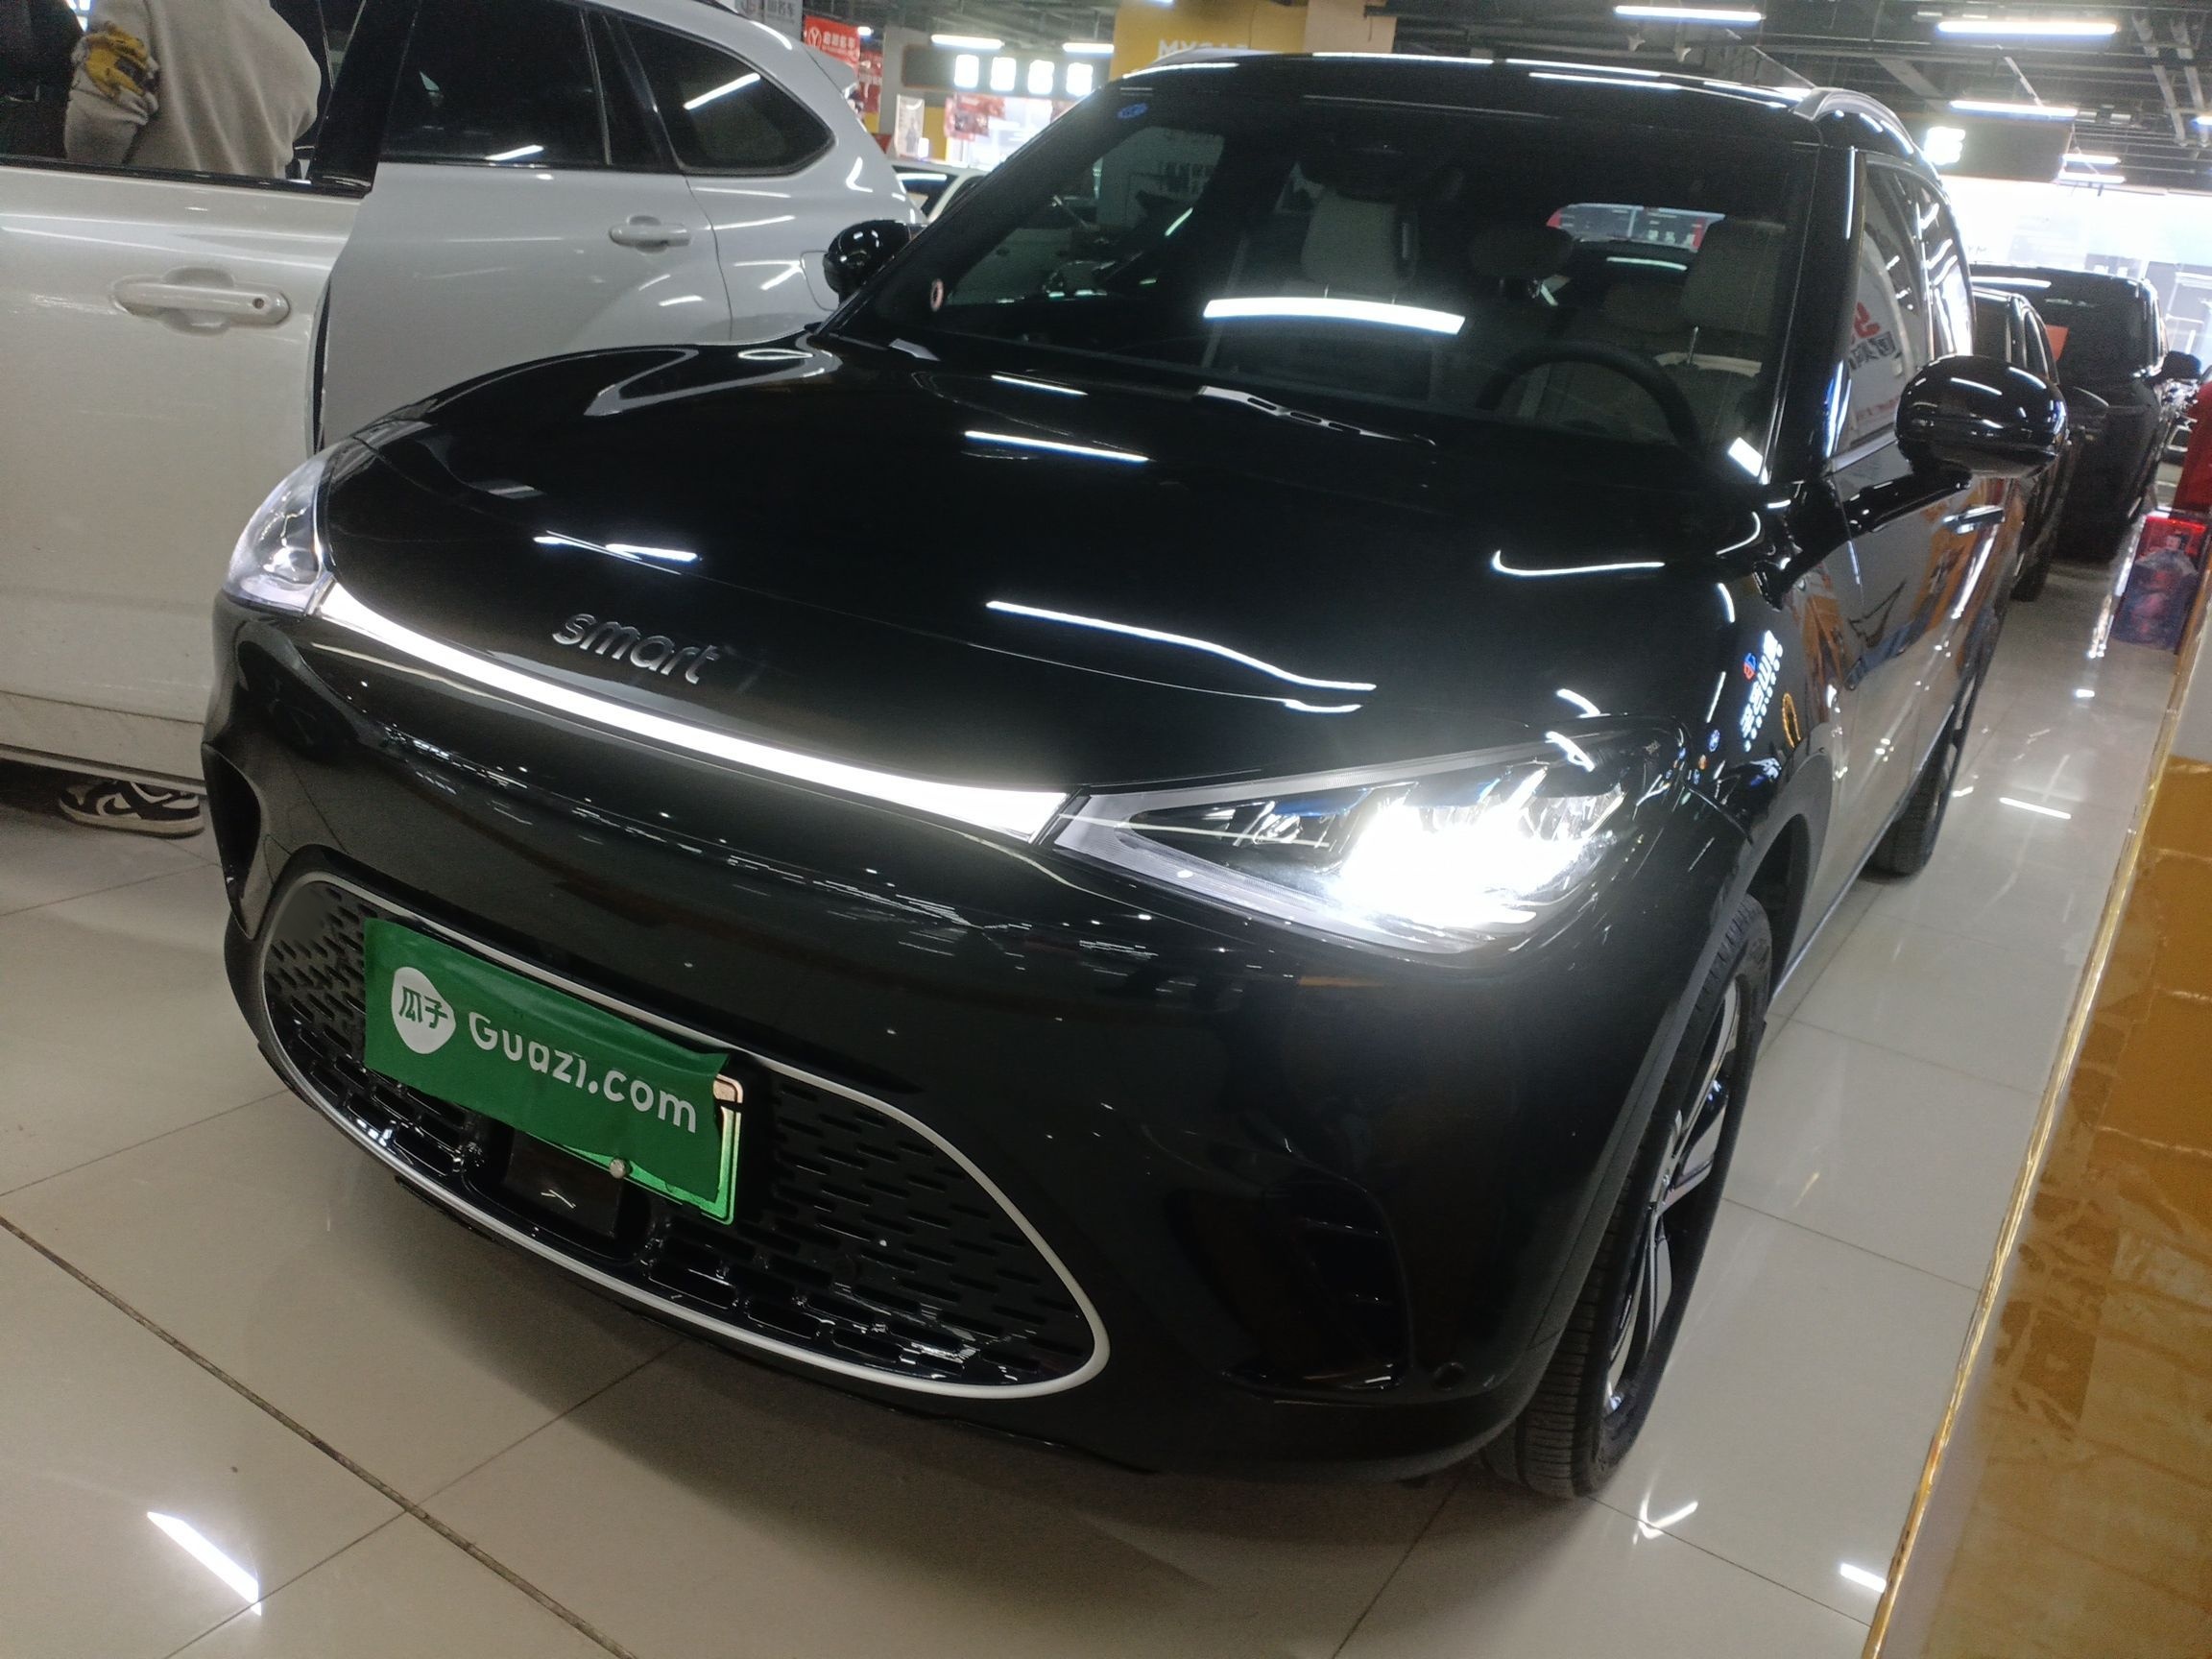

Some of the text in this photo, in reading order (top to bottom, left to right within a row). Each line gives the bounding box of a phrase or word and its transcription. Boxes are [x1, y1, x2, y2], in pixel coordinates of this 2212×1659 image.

[552, 613, 721, 685] smart
[398, 985, 449, 1030] 瓜子
[468, 1011, 697, 1134] Guazi.com
